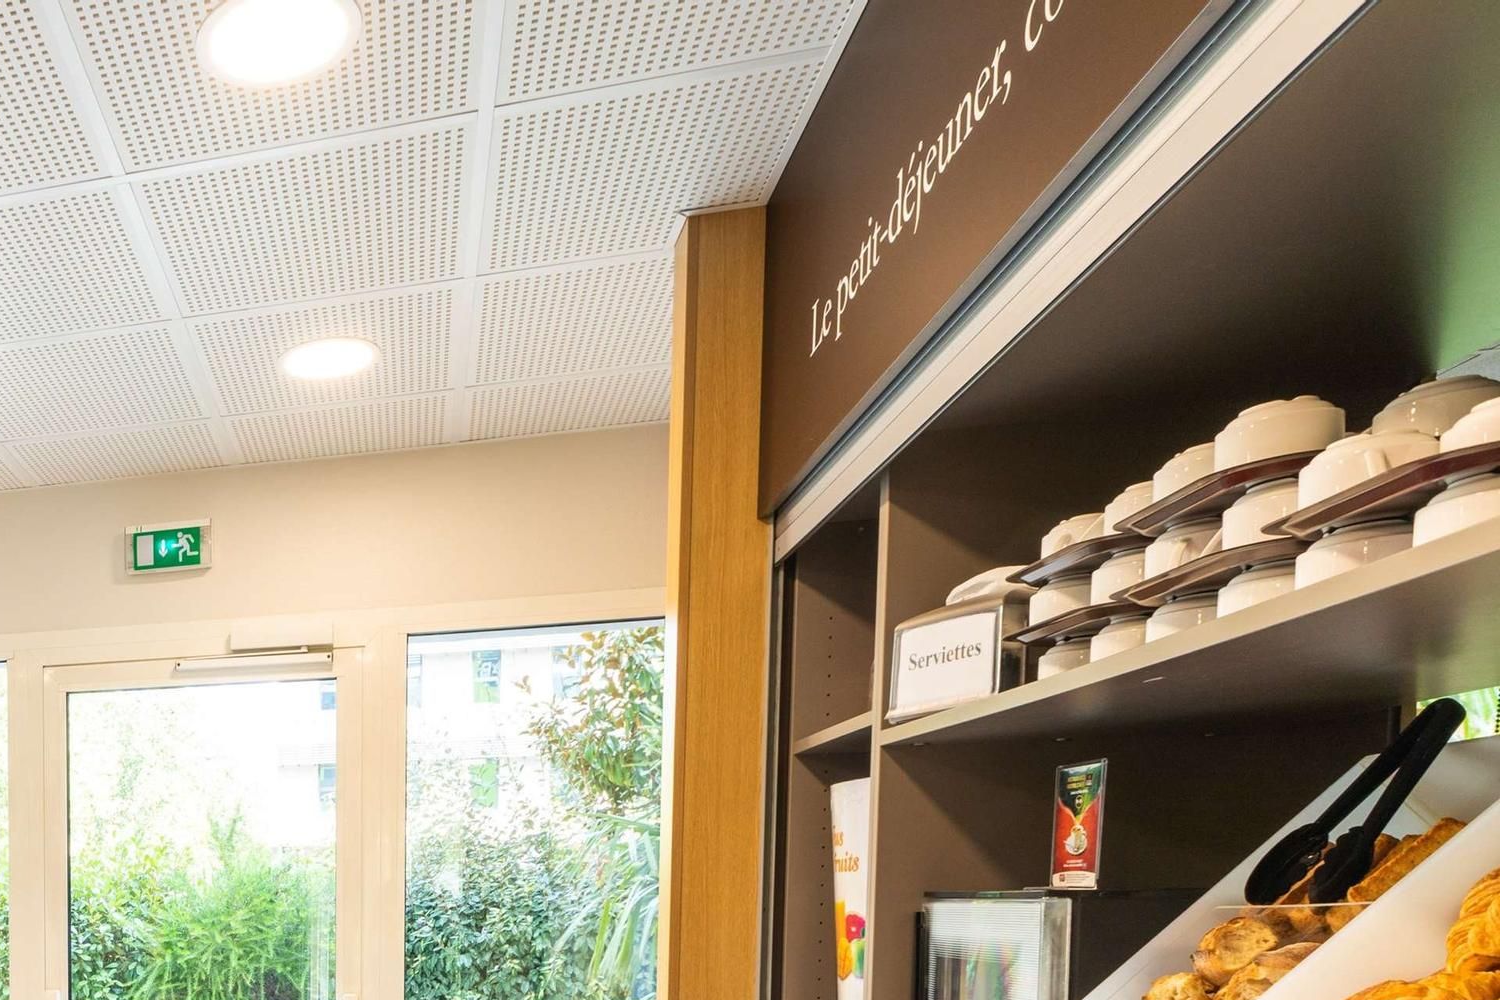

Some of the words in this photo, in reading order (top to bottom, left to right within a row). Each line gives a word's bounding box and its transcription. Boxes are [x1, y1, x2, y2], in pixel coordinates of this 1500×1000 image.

[809, 298, 833, 358] Le
[834, 39, 1012, 342] petit-déjeuner,
[907, 642, 982, 671] Serviettes
[835, 851, 860, 873] ruits
